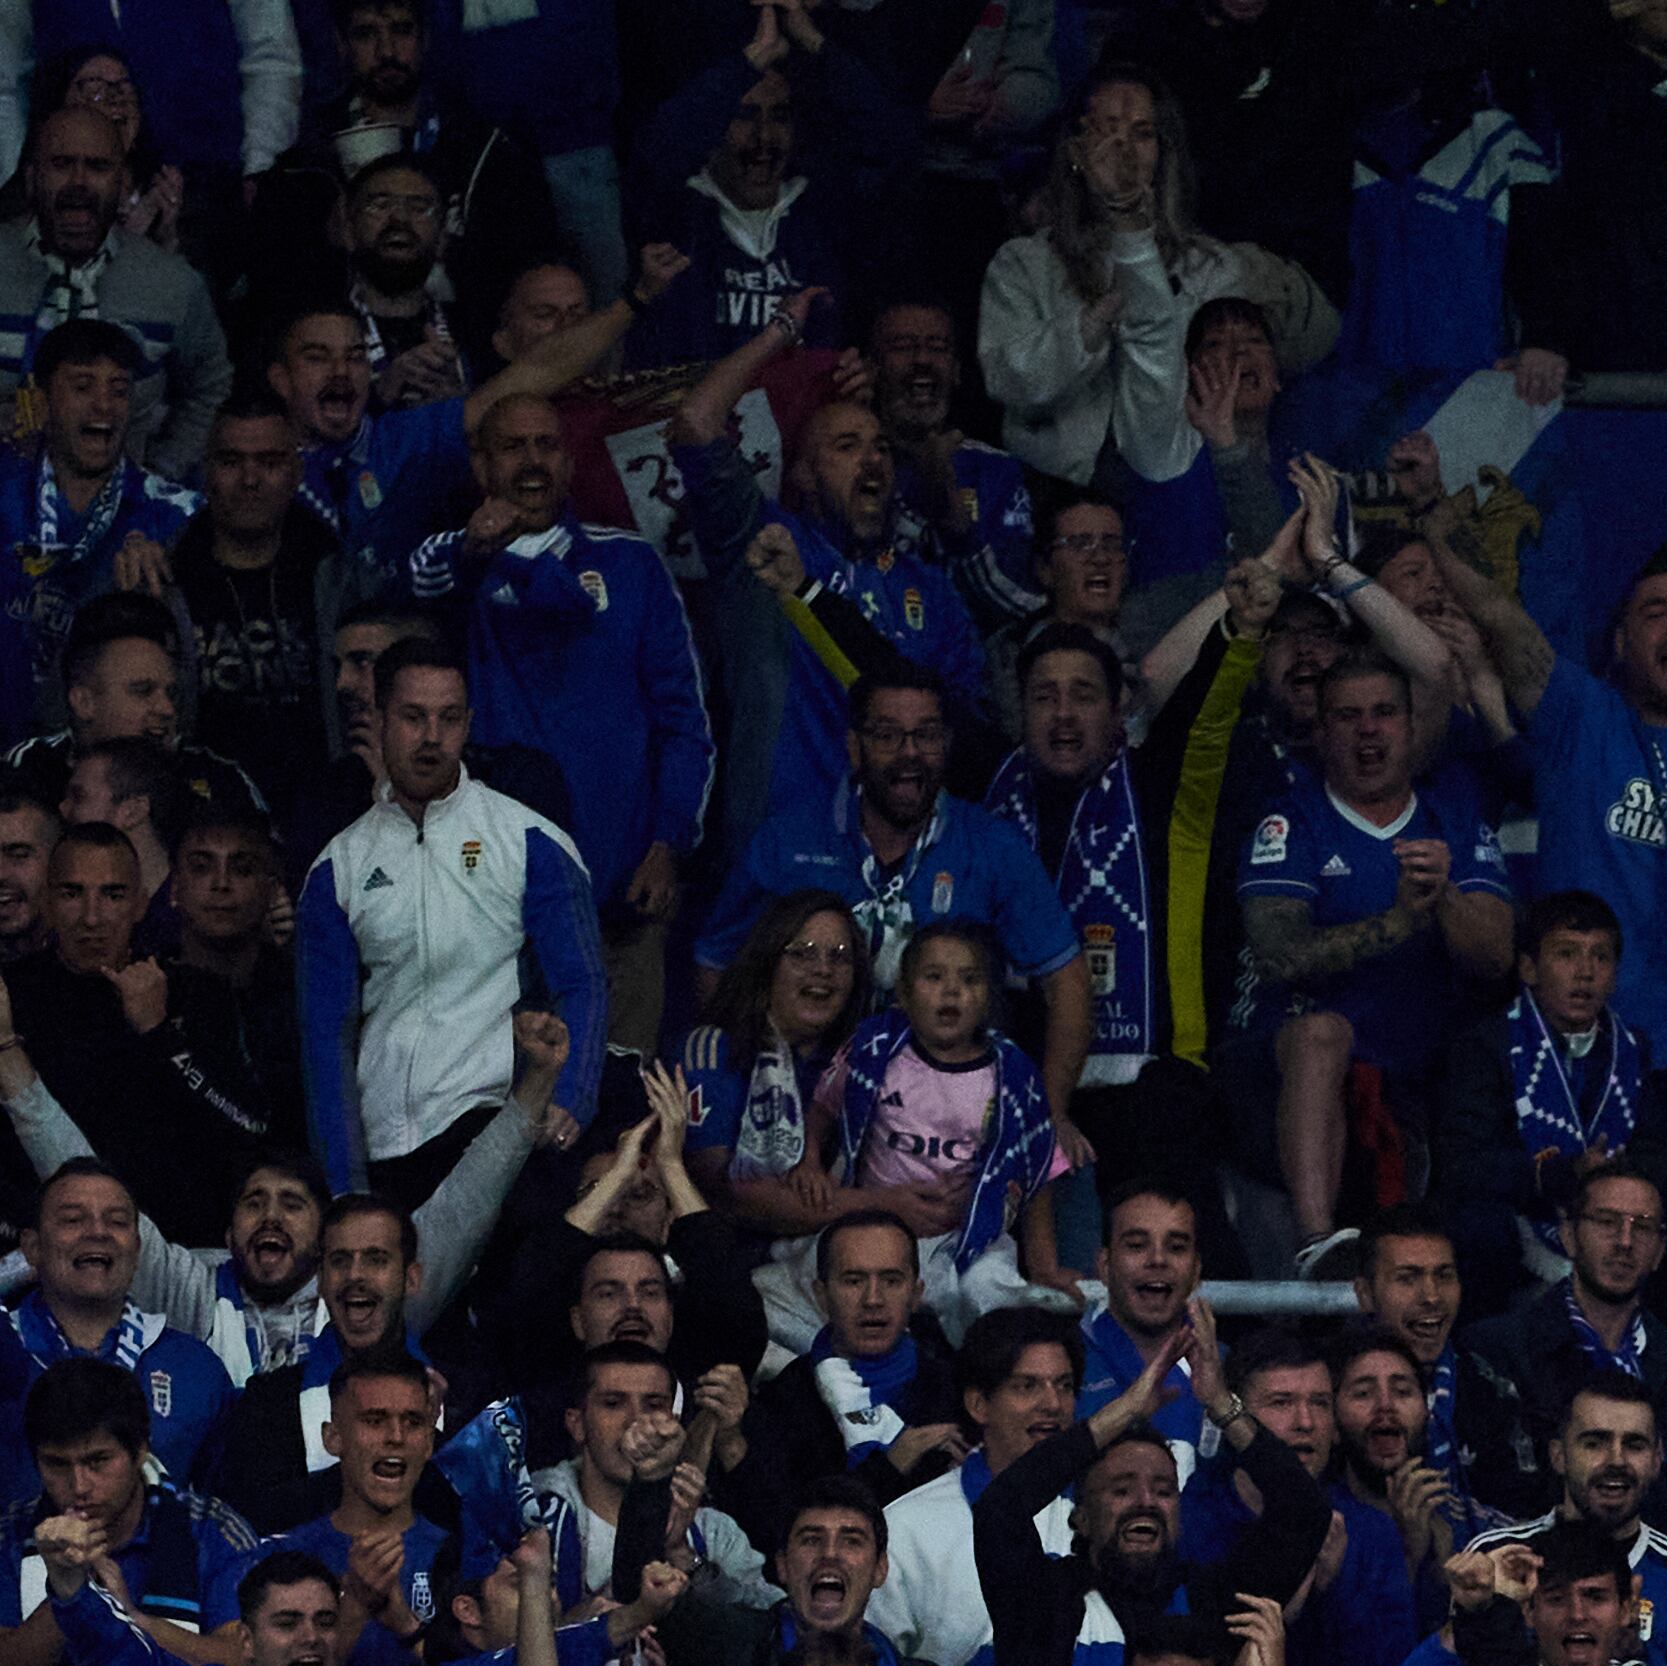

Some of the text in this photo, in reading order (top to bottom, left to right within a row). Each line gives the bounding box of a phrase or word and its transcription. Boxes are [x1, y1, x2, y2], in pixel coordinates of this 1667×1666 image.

[724, 258, 802, 292] REAL
[1609, 803, 1667, 846] CHIA
[886, 1130, 984, 1161] DIG
